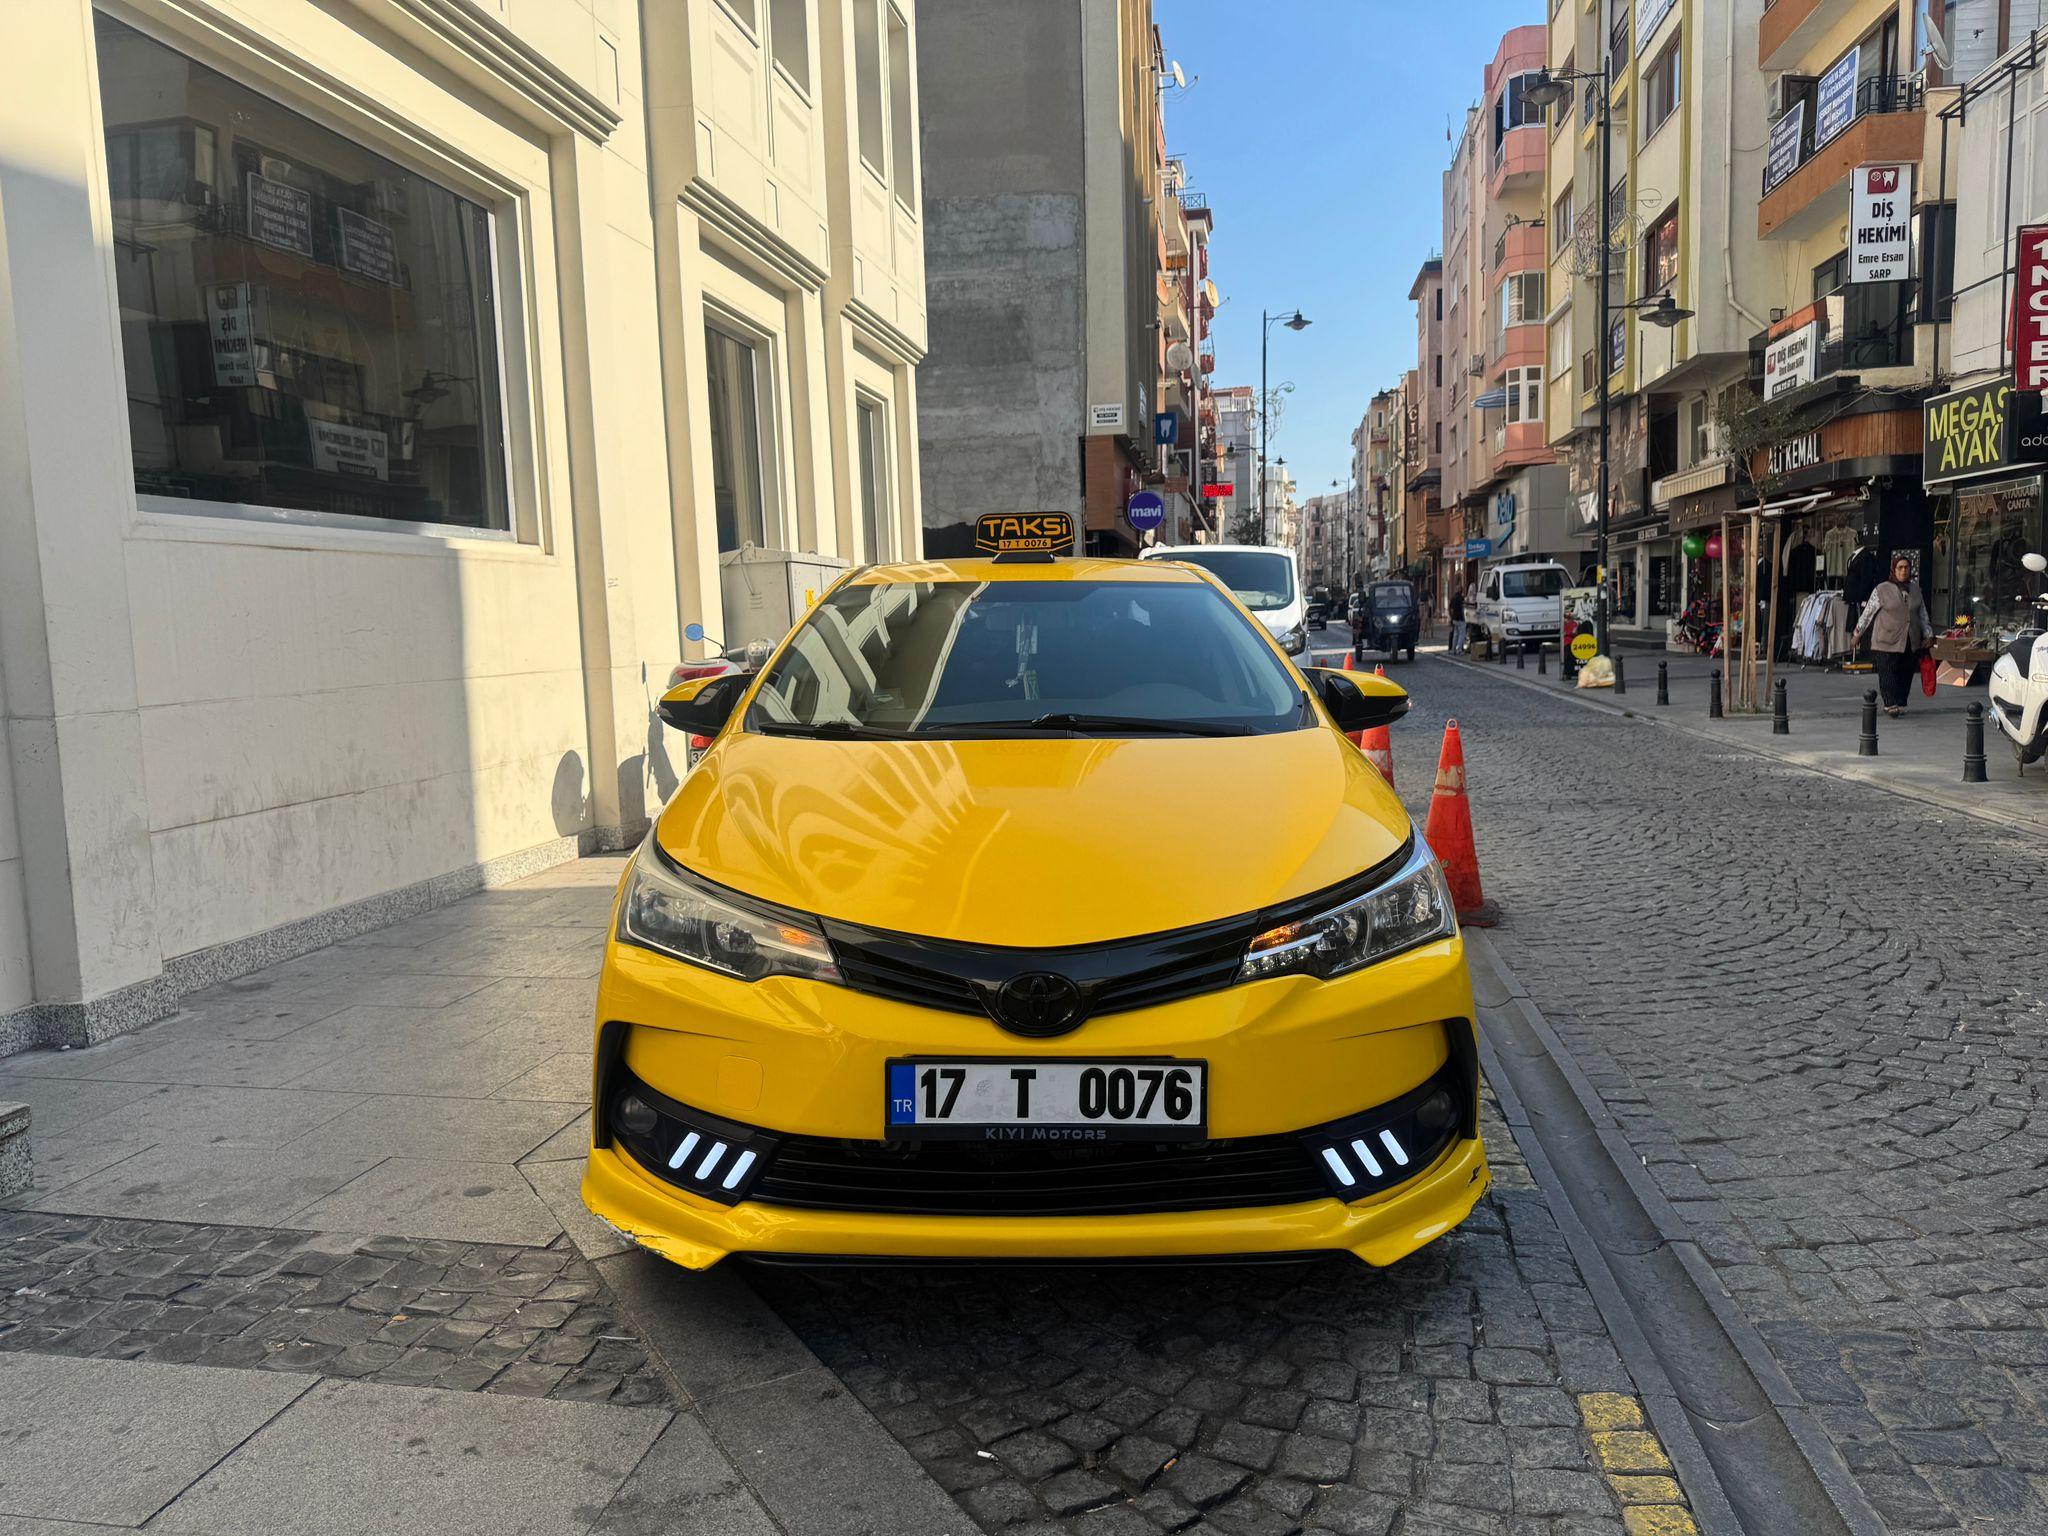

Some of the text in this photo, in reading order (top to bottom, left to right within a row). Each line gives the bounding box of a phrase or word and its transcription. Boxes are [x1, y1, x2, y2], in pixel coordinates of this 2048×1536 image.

[1872, 198, 1894, 221] DİŞ
[1858, 222, 1906, 244] HEKİMİ
[1858, 252, 1904, 264] Emre Ersan
[1869, 269, 1891, 279] SARP
[1777, 333, 1808, 364] DİŞ HEKİMİ
[1785, 433, 1820, 472] KEMAL
[1940, 424, 1999, 472] AYAK
[1131, 504, 1162, 518] mavi
[1024, 539, 1048, 547] 0076
[894, 1067, 1193, 1121] TR 17 T 0076
[985, 1127, 1107, 1141] KIYI MOTORS
